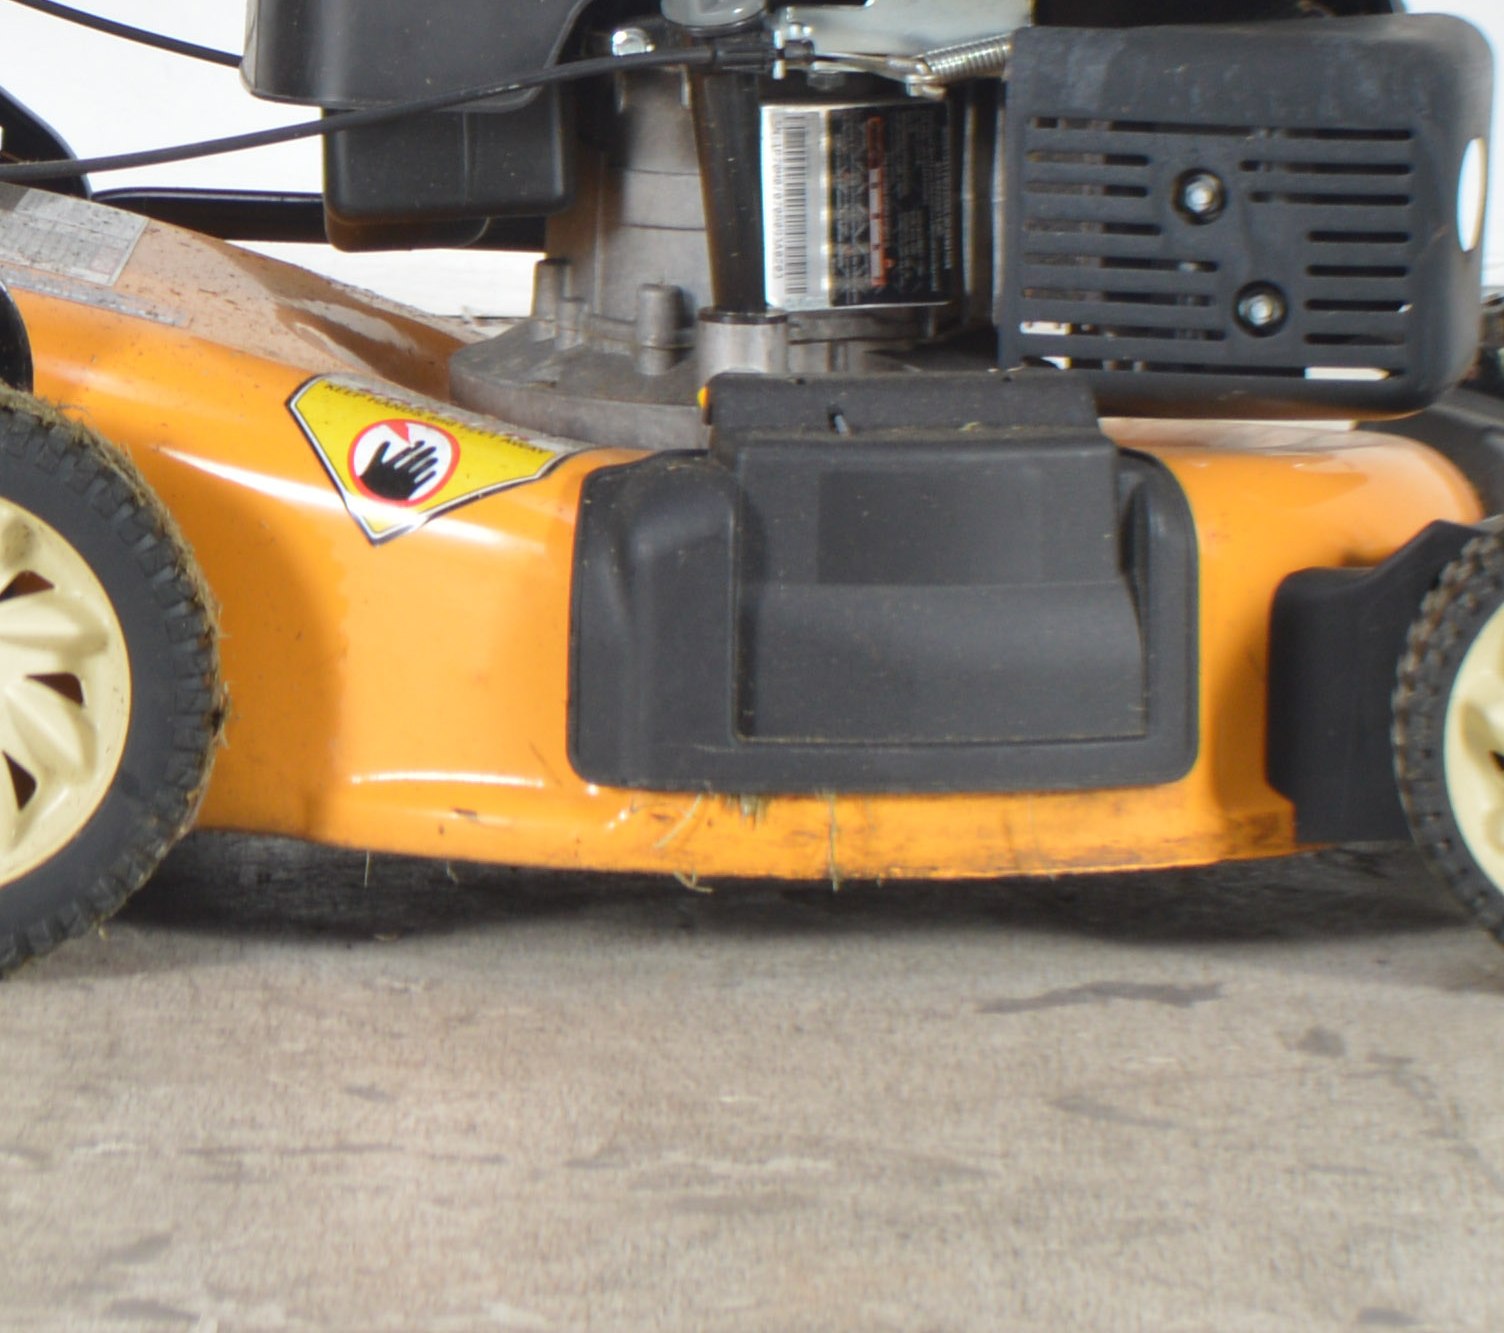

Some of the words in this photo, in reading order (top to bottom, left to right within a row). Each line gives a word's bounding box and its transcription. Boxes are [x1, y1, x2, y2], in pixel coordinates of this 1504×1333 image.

[324, 382, 366, 399] KEEP
[367, 393, 423, 417] HANDS
[500, 435, 546, 455] AWAY
